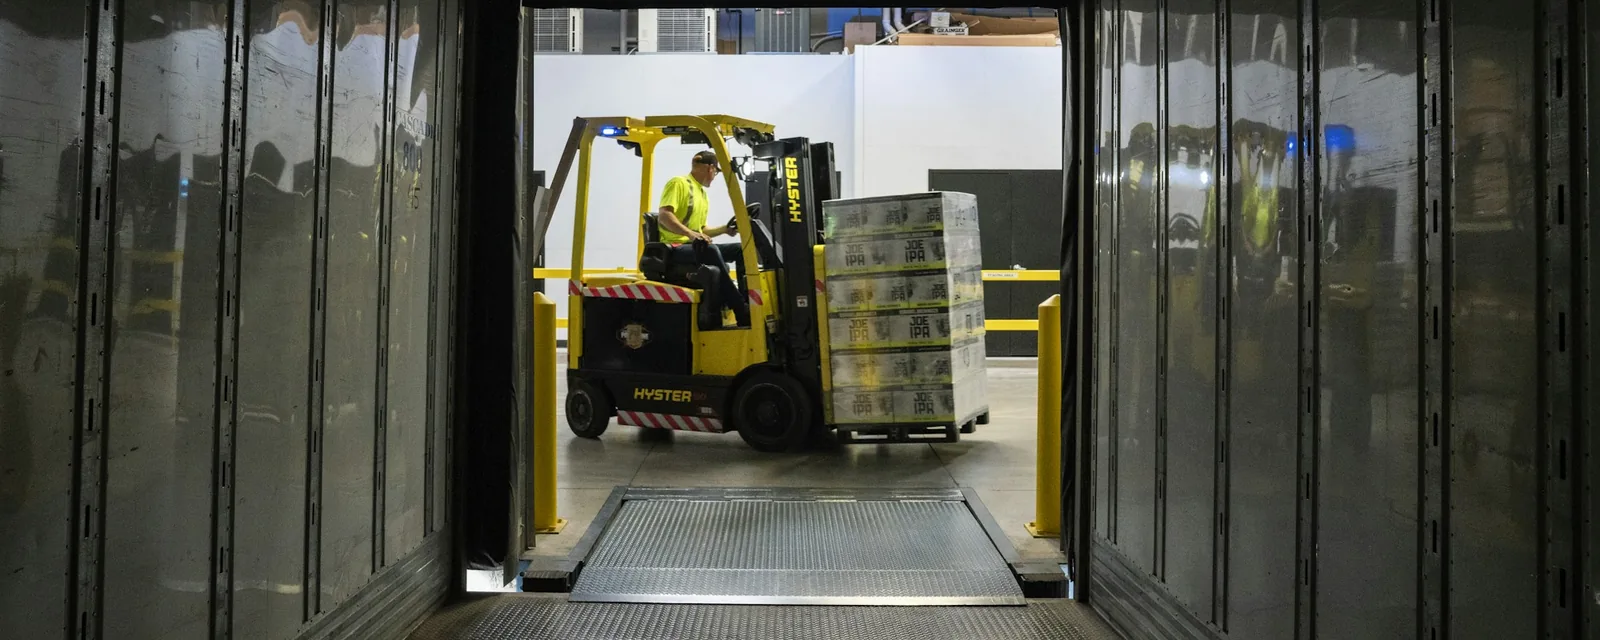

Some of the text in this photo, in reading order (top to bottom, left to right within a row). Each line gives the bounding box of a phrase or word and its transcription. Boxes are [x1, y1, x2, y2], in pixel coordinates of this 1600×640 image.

[784, 156, 802, 222] HYSTER
[846, 244, 864, 254] JOE
[905, 240, 924, 250] JOE
[846, 254, 865, 266] IPA
[905, 250, 926, 263] IPA
[849, 319, 868, 328] JOE
[910, 316, 928, 326] JOE
[850, 329, 869, 341] IPA
[910, 326, 930, 339] IPA
[634, 388, 692, 402] HYSTER
[854, 394, 872, 403] JOE
[914, 392, 933, 402] JOE
[853, 403, 872, 416] IPA
[914, 402, 934, 414] IPA
